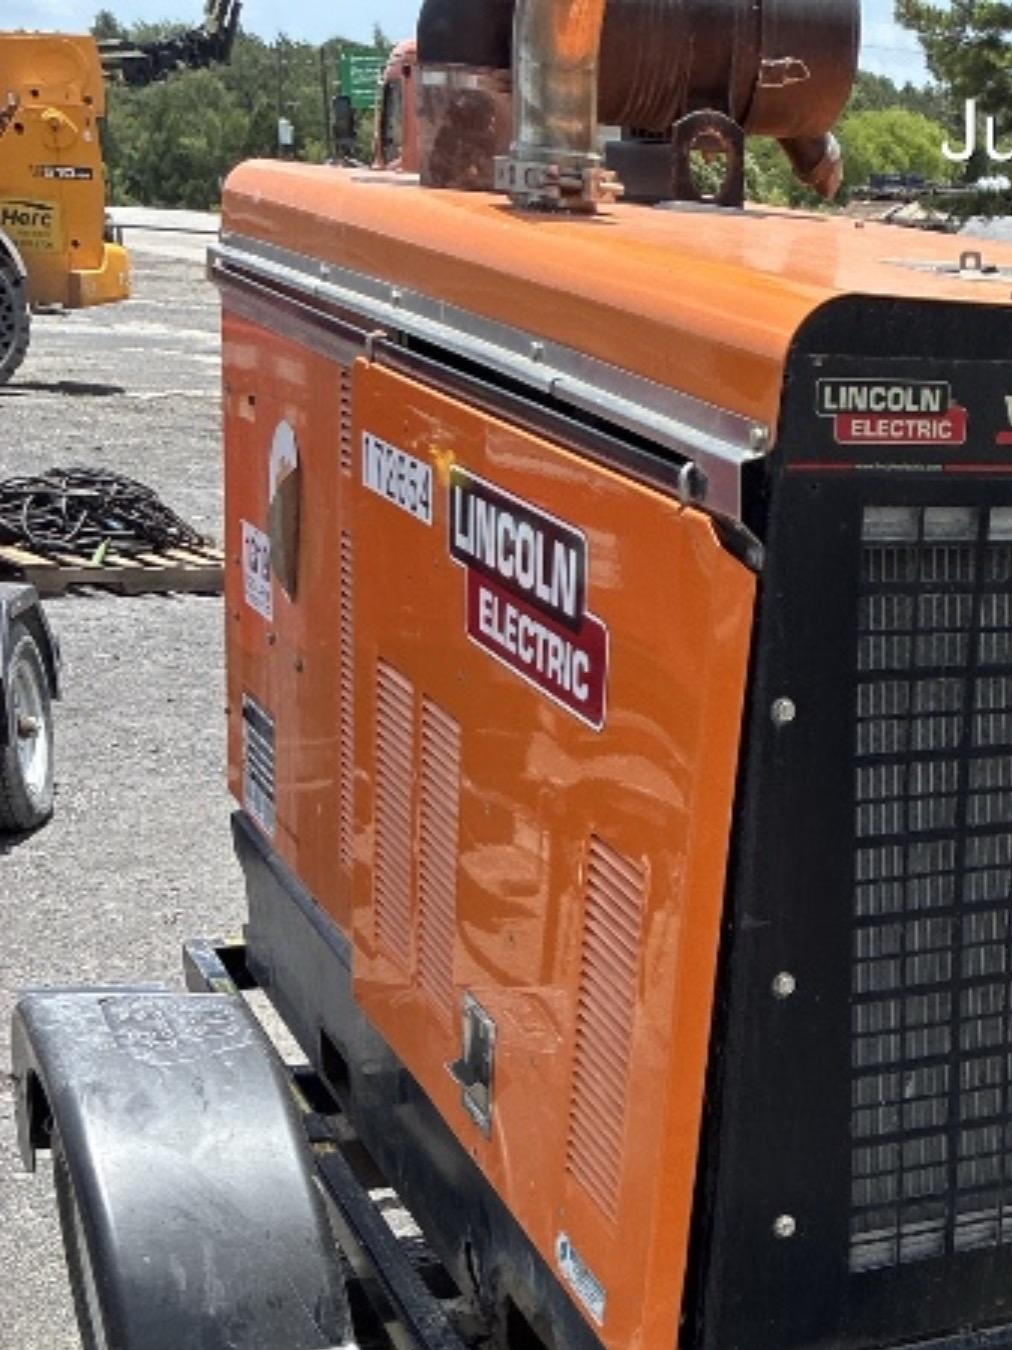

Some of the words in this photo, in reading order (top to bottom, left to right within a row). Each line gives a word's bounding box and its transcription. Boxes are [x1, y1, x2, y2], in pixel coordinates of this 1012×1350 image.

[823, 385, 941, 413] LINCOLN
[850, 418, 953, 439] ELECTRIC
[454, 484, 577, 618] LINCOLN
[478, 586, 590, 701] ELECTRIC
